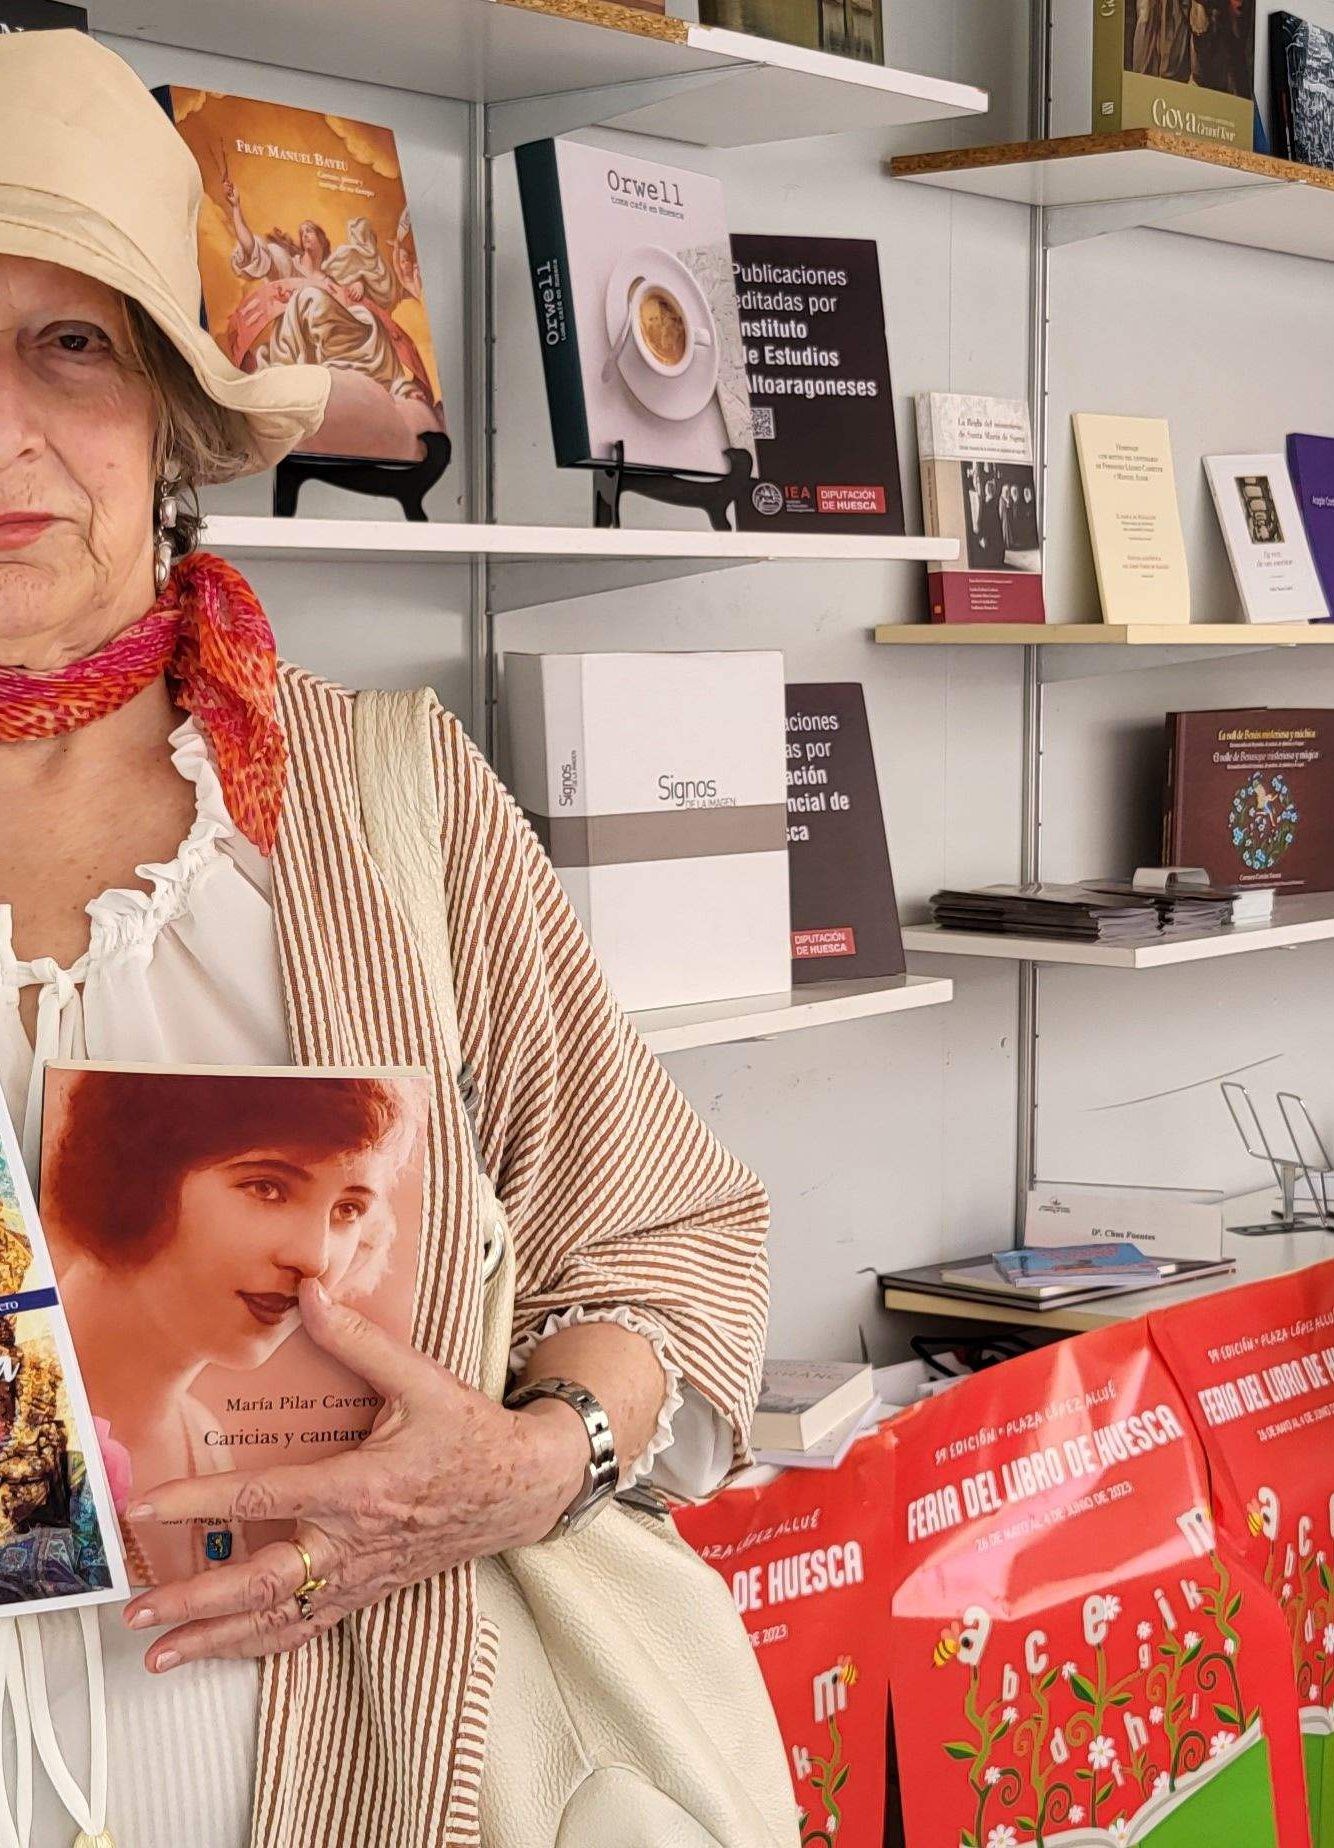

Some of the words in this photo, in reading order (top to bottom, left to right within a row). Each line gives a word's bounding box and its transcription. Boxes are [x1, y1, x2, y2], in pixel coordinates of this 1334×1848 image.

[1152, 98, 1196, 136] Goya
[236, 139, 264, 156] FRAY
[267, 143, 314, 166] MANUEL
[607, 169, 684, 207] Orwell
[731, 262, 849, 287] Publicaciones
[537, 260, 560, 346] Orwell
[735, 291, 804, 311] editadas
[808, 296, 838, 316] por
[740, 318, 809, 339] nstituto
[764, 345, 840, 367] Estudios
[784, 485, 811, 499] IEA
[820, 488, 876, 500] DIPUTACIÓN
[822, 501, 835, 510] DE
[836, 501, 877, 511] HUESCA
[806, 742, 832, 761] por
[558, 764, 576, 807] Signos
[658, 774, 717, 807] Signos
[830, 791, 850, 811] de
[794, 932, 846, 945] DIPUTACIÓN
[795, 945, 809, 955] DE
[809, 943, 847, 955] HUESCA
[1126, 1231, 1156, 1241] Fuentes
[1220, 1336, 1254, 1361] EDICIÓN
[1261, 1329, 1288, 1347] PLAZA
[1291, 1320, 1314, 1337] LÓPEZ
[1197, 1381, 1244, 1426] FERIA
[1236, 1373, 1271, 1414] DEL
[1262, 1360, 1310, 1403] LIBRO
[1301, 1353, 1330, 1389] DE
[226, 1396, 273, 1412] María
[280, 1396, 318, 1411] Pilar
[322, 1394, 379, 1408] Cavero
[949, 1427, 998, 1459] EDICIÓN
[1006, 1413, 1043, 1437] PLAZA
[1085, 1380, 1117, 1410] ALLUÉ
[204, 1428, 279, 1447] Caricias
[284, 1432, 294, 1449] y
[300, 1428, 372, 1444] cantare
[907, 1485, 963, 1543] FERIA
[962, 1470, 1003, 1519] DEL
[1001, 1447, 1065, 1503] LIBRO
[1063, 1435, 1098, 1480] DE
[1093, 1404, 1185, 1468] HUESCA
[736, 1528, 772, 1552] LÓPEZ
[774, 1507, 822, 1538] ALLUÉ
[732, 1566, 763, 1615] DE
[768, 1540, 864, 1606] HUESCA
